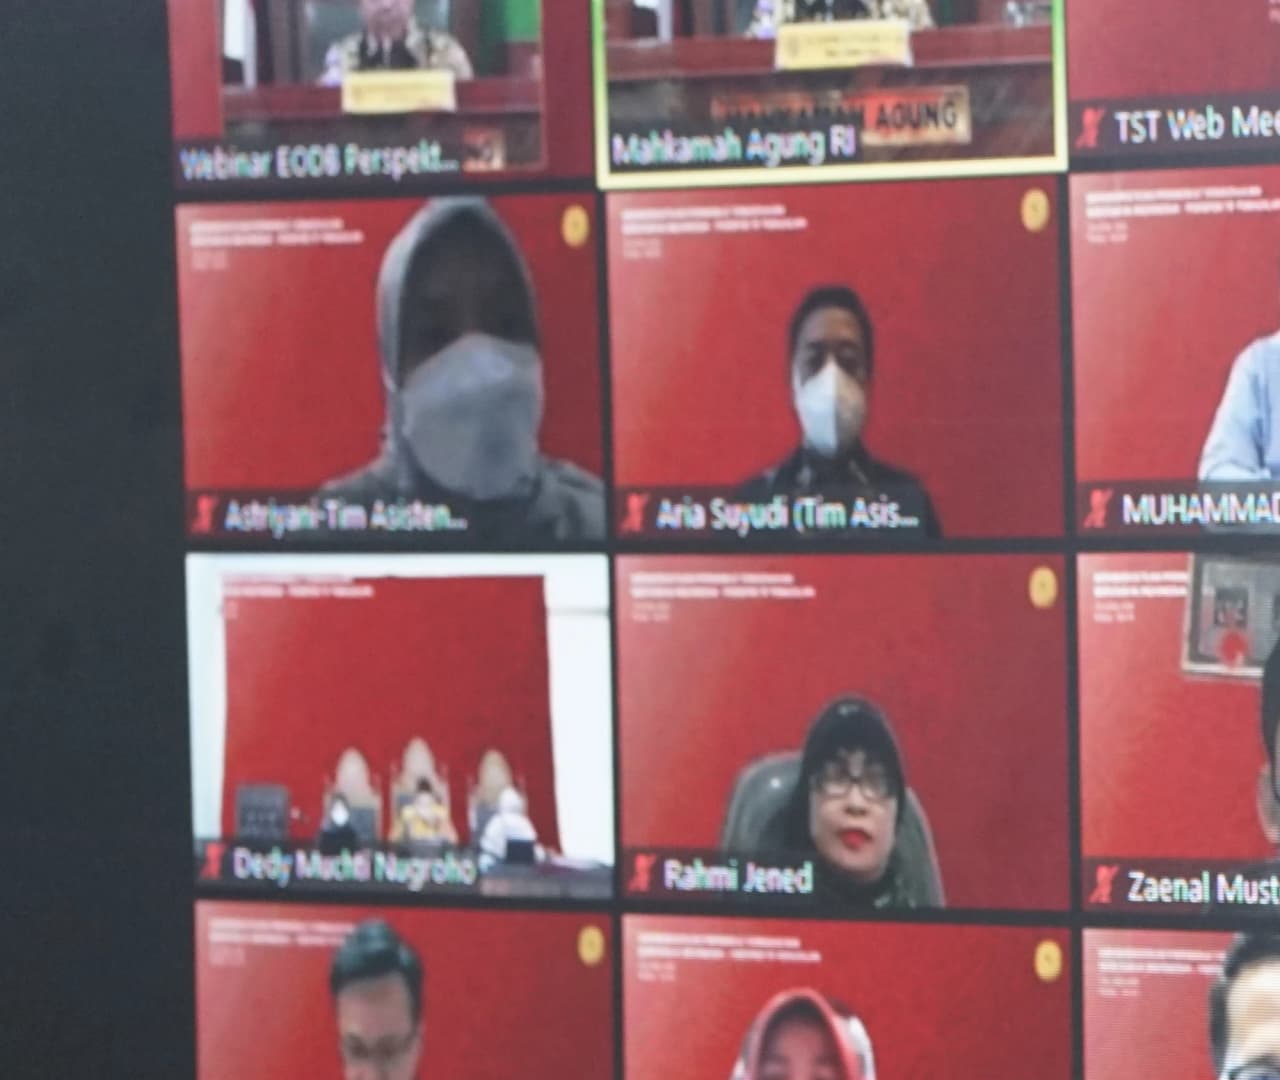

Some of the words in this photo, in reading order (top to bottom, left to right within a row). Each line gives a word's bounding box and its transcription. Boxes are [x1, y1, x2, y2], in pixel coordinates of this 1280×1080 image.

[1114, 109, 1161, 143] TST
[1167, 103, 1225, 141] Web
[612, 127, 742, 165] Mahkamah
[746, 128, 826, 168] Agung
[830, 124, 857, 157] RI
[656, 497, 706, 529] Aria
[708, 495, 789, 538] Suyudi
[793, 496, 848, 534] (Tim
[233, 846, 294, 889] Dedy
[374, 846, 477, 892] Nugroho
[663, 857, 739, 891] Rahmi
[743, 860, 814, 894] Jened
[1127, 869, 1212, 904] Zaenal
